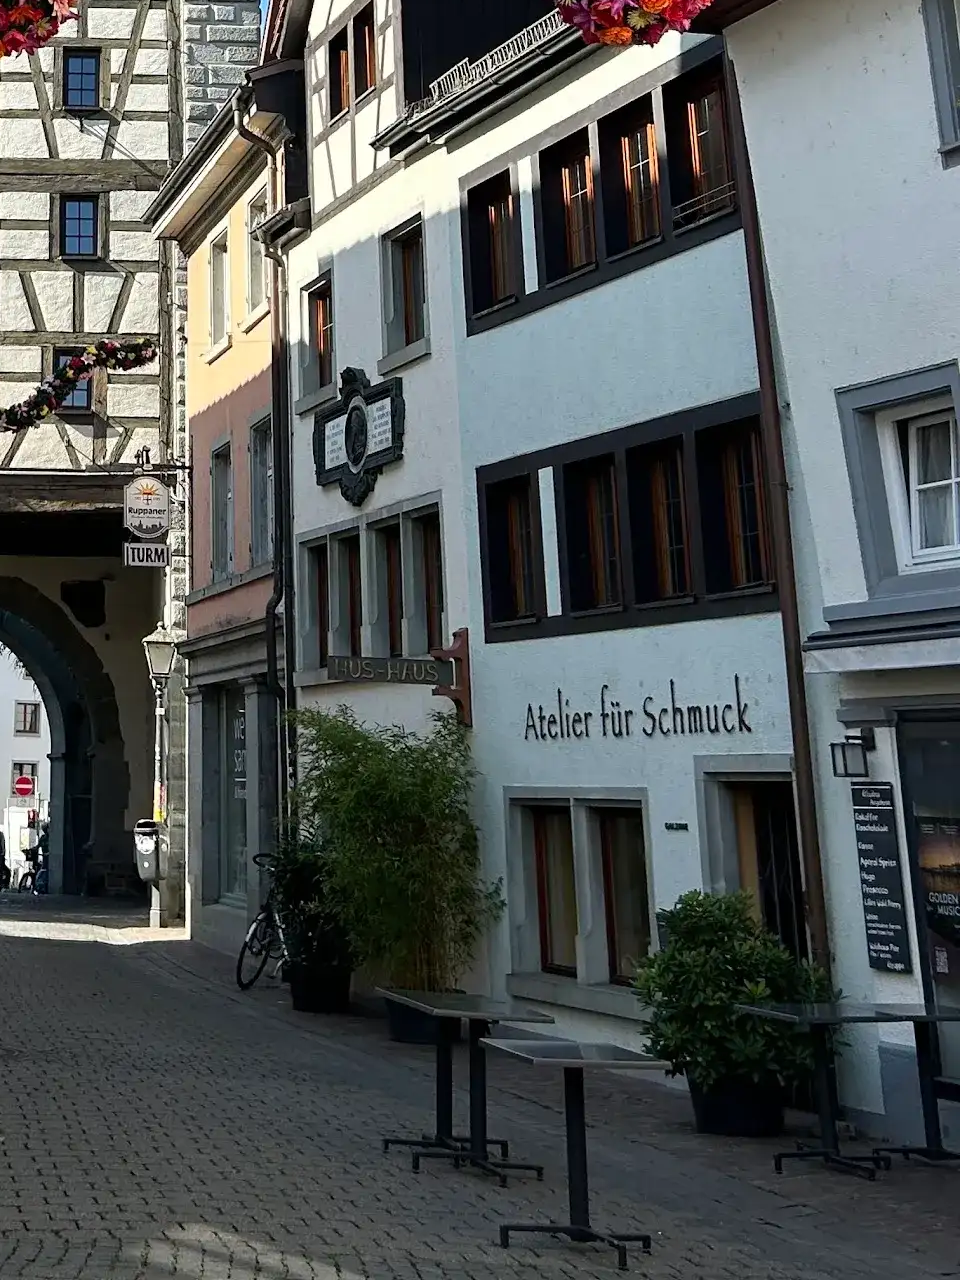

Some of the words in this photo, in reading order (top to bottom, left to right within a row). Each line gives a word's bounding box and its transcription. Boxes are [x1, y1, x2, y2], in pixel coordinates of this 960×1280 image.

[128, 507, 167, 516] Ruppaner
[130, 547, 165, 563] TURM
[335, 659, 439, 681] HUS-HAUS
[524, 687, 593, 742] Atelier
[600, 684, 634, 738] für
[642, 673, 752, 738] Schmuck
[928, 892, 959, 904] GOLDEN
